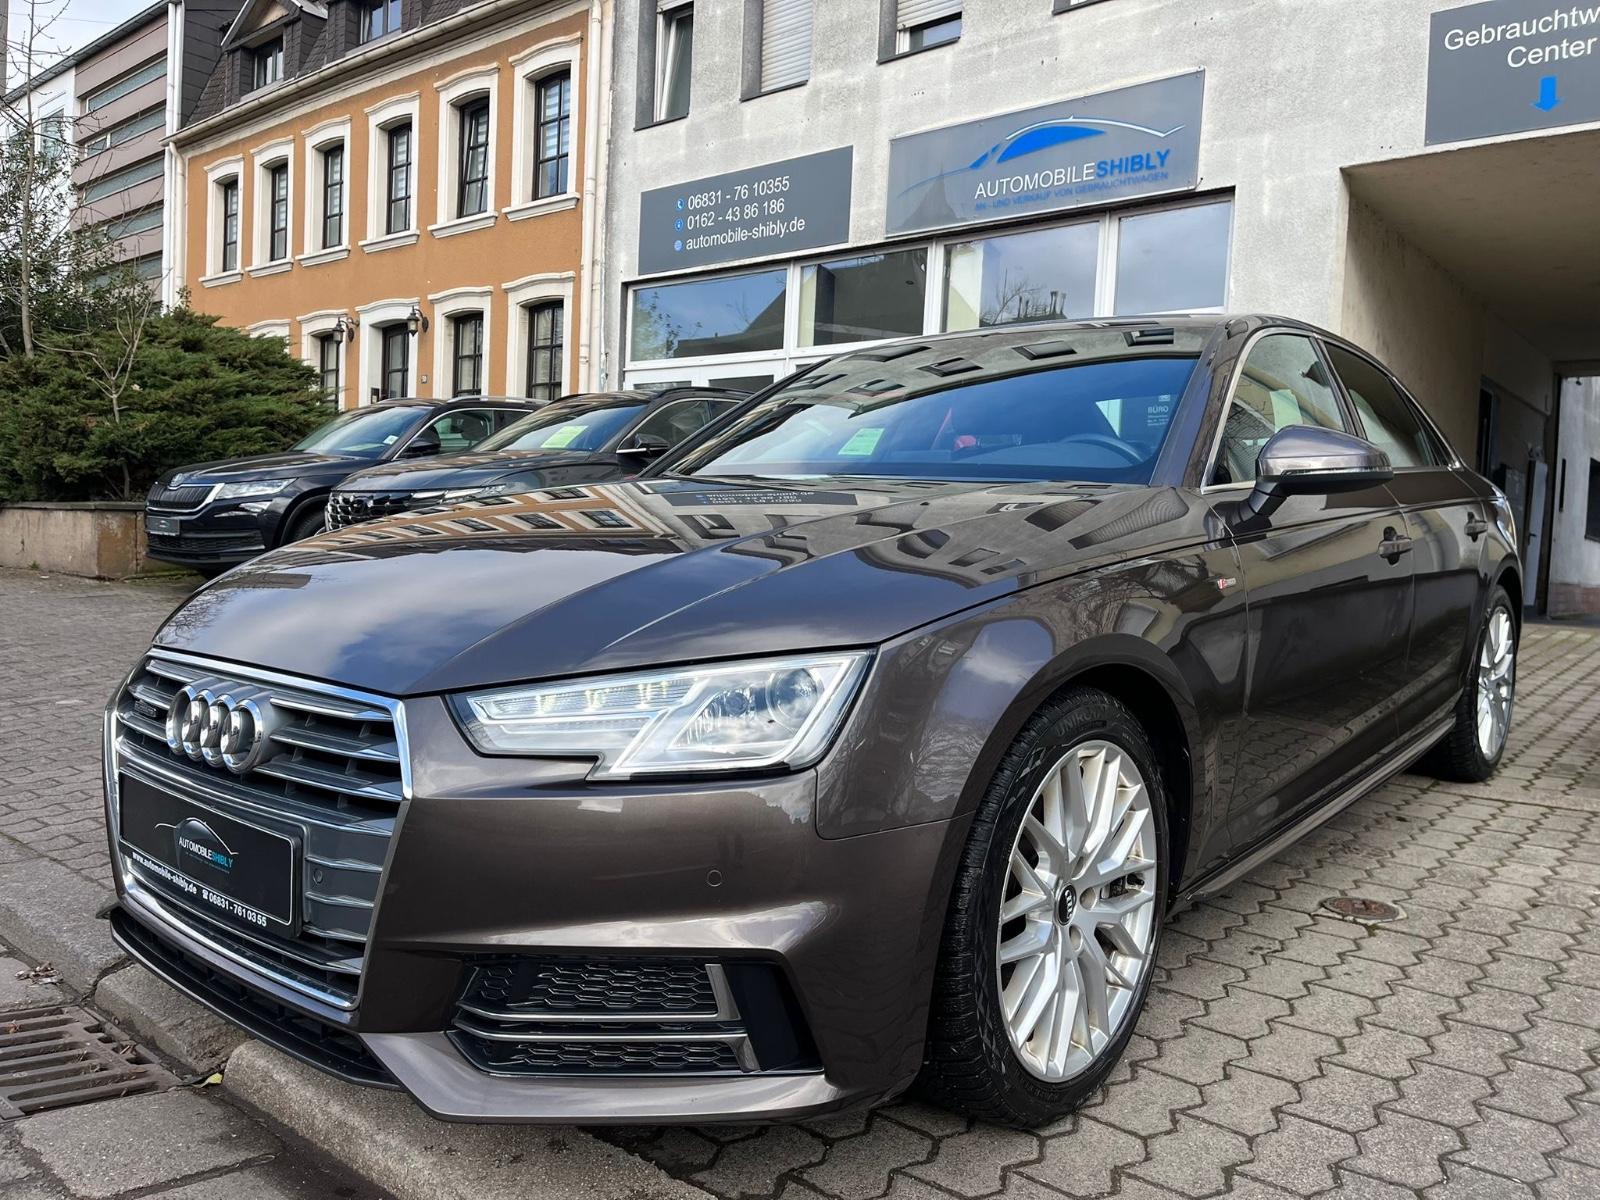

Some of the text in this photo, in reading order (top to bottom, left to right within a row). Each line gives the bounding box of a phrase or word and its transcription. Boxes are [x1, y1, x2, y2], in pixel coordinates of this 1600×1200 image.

[1507, 36, 1598, 68] Center
[687, 190, 722, 210] 06831
[734, 184, 749, 200] 76
[752, 175, 790, 197] 10355
[1013, 189, 1051, 206] VERKAUF
[1054, 188, 1073, 198] VON
[1075, 171, 1169, 194] GEBRAUCHTWAGEN
[686, 212, 715, 230] 0162
[725, 207, 740, 222] 43
[744, 202, 759, 219] 86
[763, 197, 785, 215] 186
[686, 216, 806, 250] automobile-shibly.de
